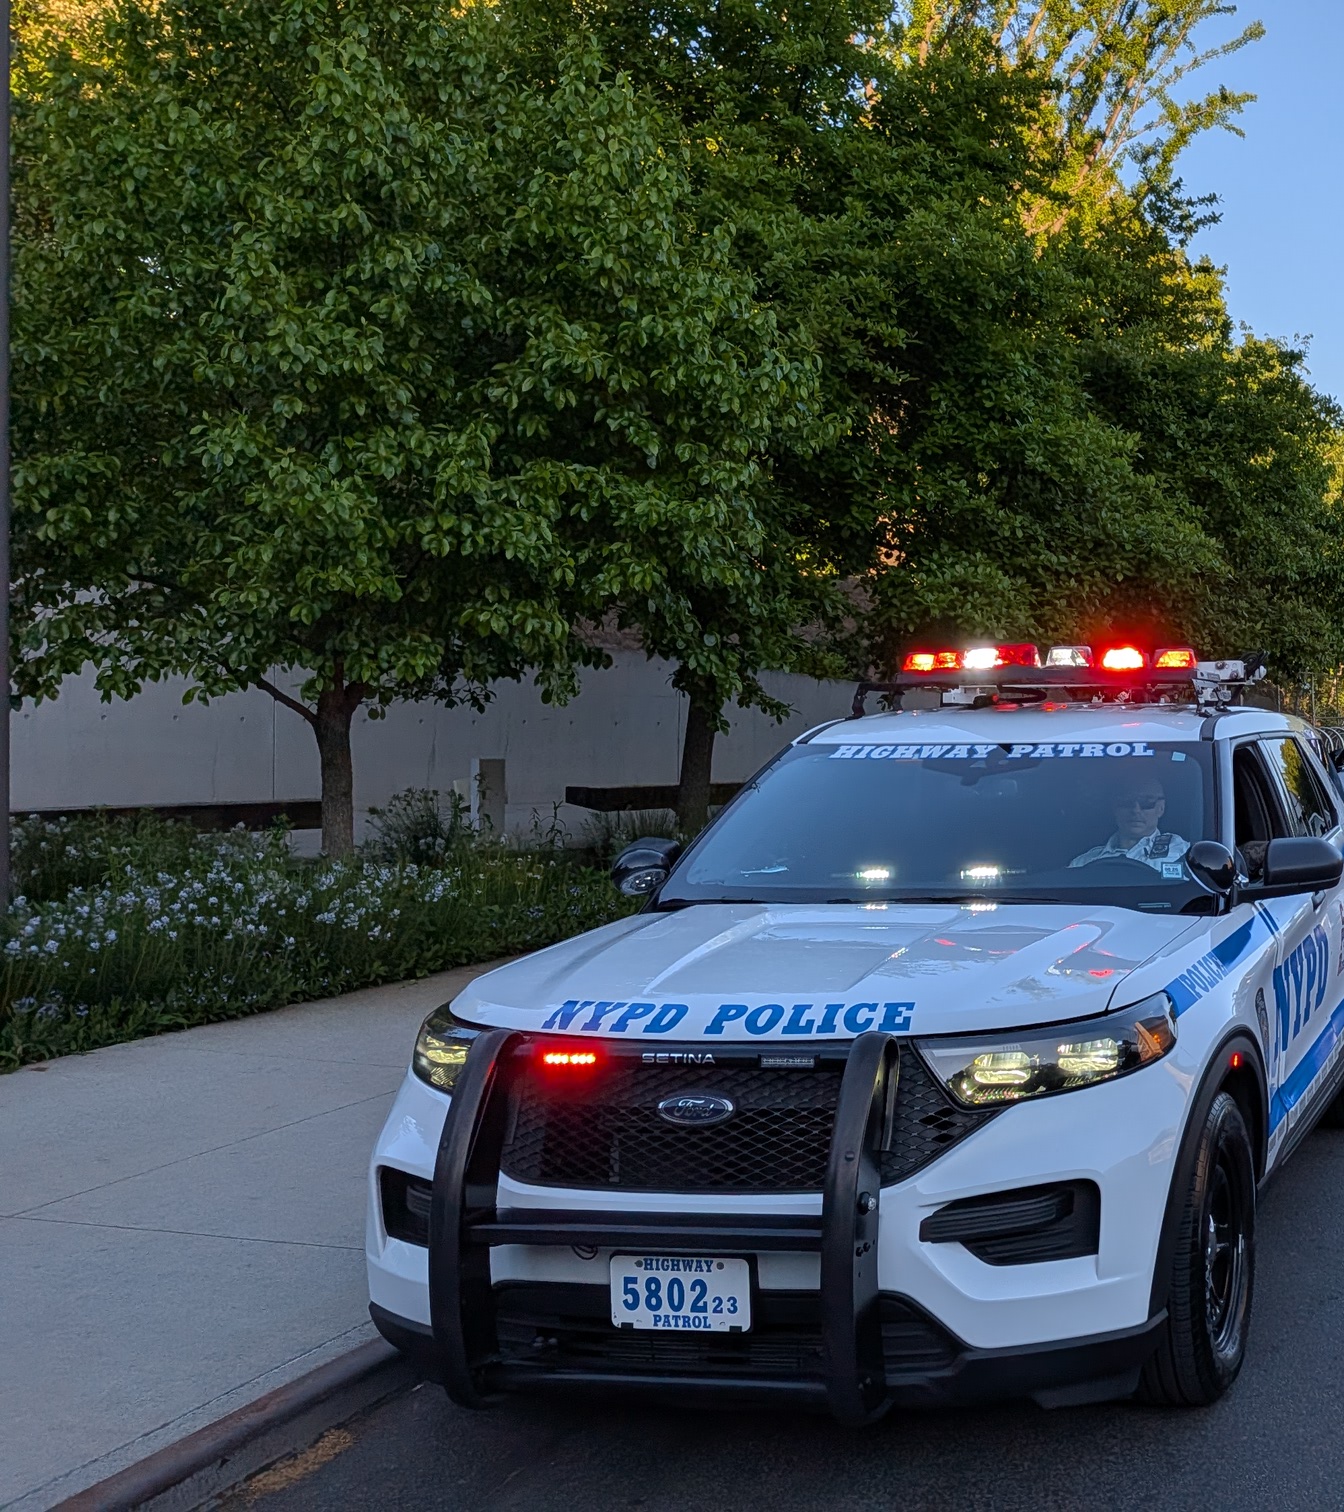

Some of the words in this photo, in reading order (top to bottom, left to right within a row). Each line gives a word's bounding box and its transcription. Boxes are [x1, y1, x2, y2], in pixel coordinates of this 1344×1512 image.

[829, 745, 998, 759] HIGHWAY
[1006, 743, 1154, 758] PATROL
[1180, 952, 1227, 1000] POLICE
[1273, 923, 1329, 1063] NYPD
[541, 1000, 689, 1034] NYPD
[704, 1001, 915, 1036] POLICE
[641, 1053, 716, 1065] SETINA
[673, 1099, 715, 1119] Ford
[643, 1258, 713, 1272] HIGHWAY
[622, 1276, 708, 1313] 5802
[712, 1296, 738, 1314] 23
[653, 1315, 711, 1329] PATROL
